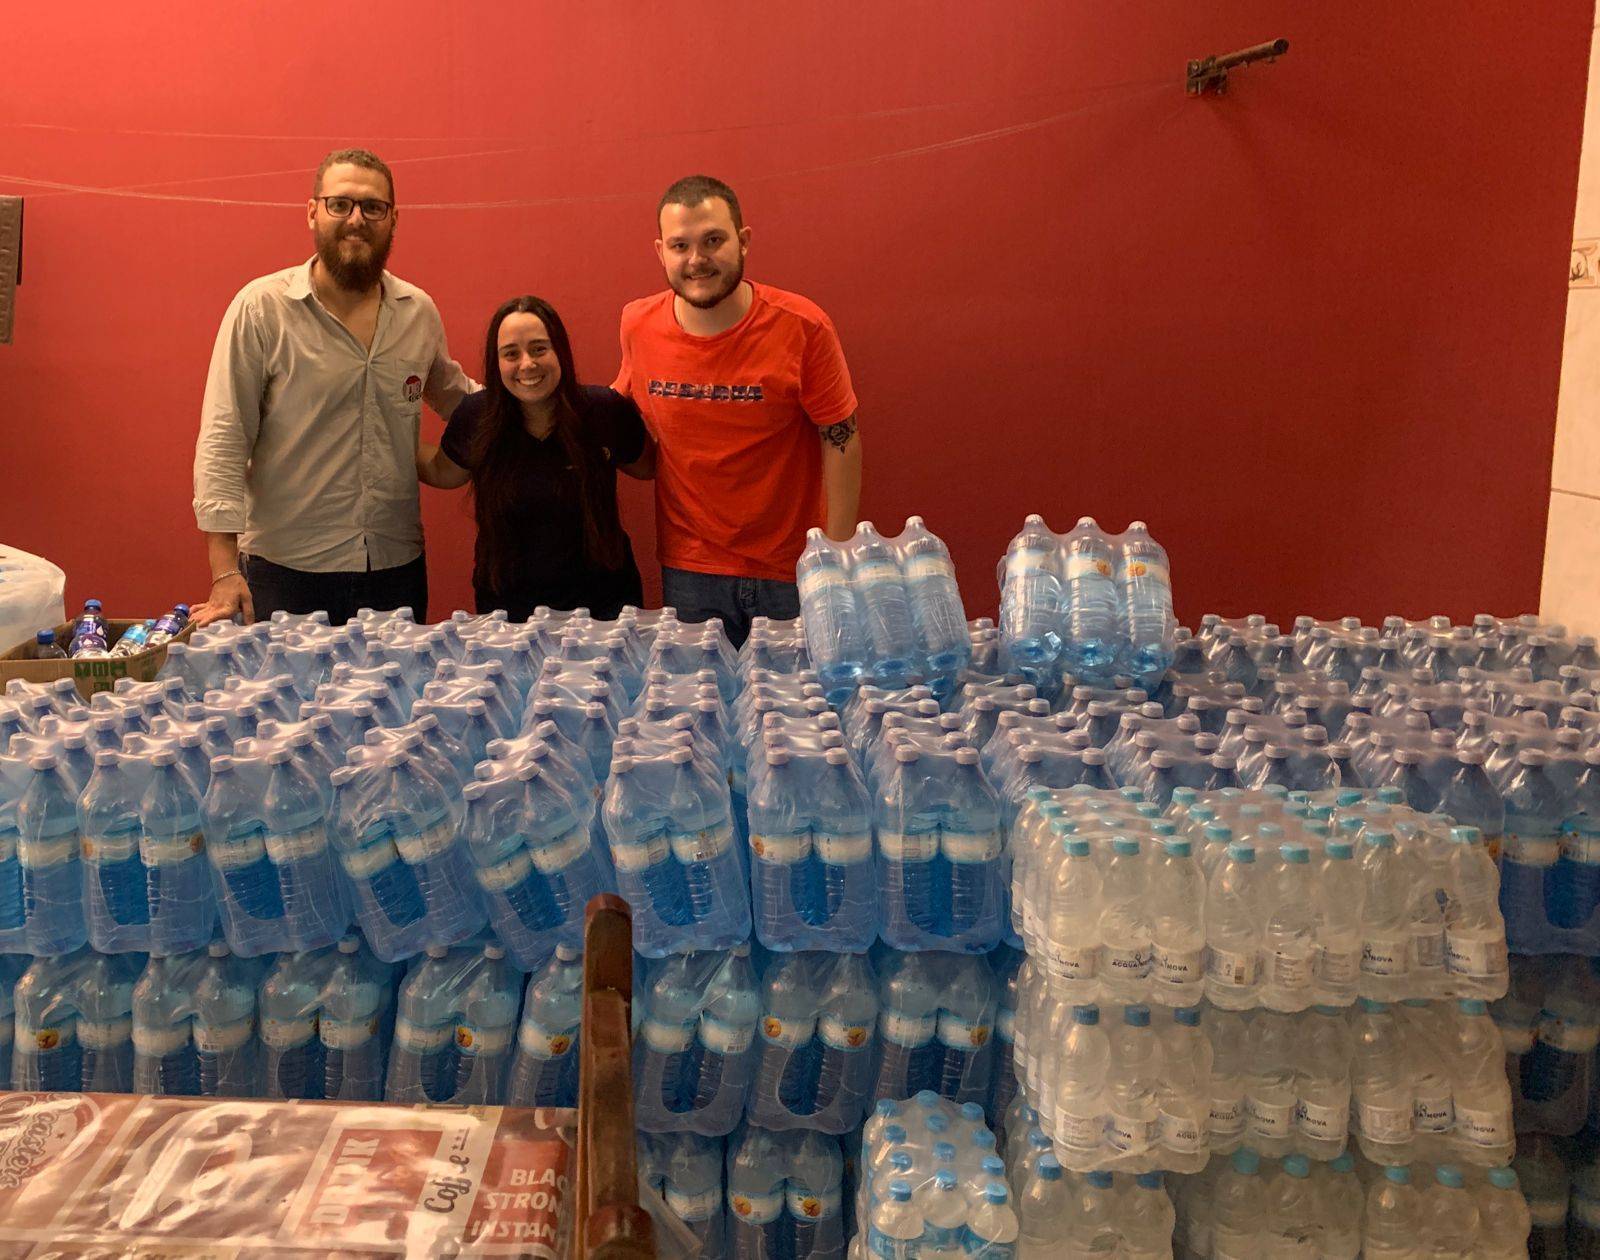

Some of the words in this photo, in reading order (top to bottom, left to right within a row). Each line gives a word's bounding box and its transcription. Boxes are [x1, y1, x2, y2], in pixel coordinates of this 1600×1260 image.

[510, 1168, 569, 1192] BLAC
[484, 1191, 561, 1214] STRON
[470, 1220, 557, 1240] INSTAN
